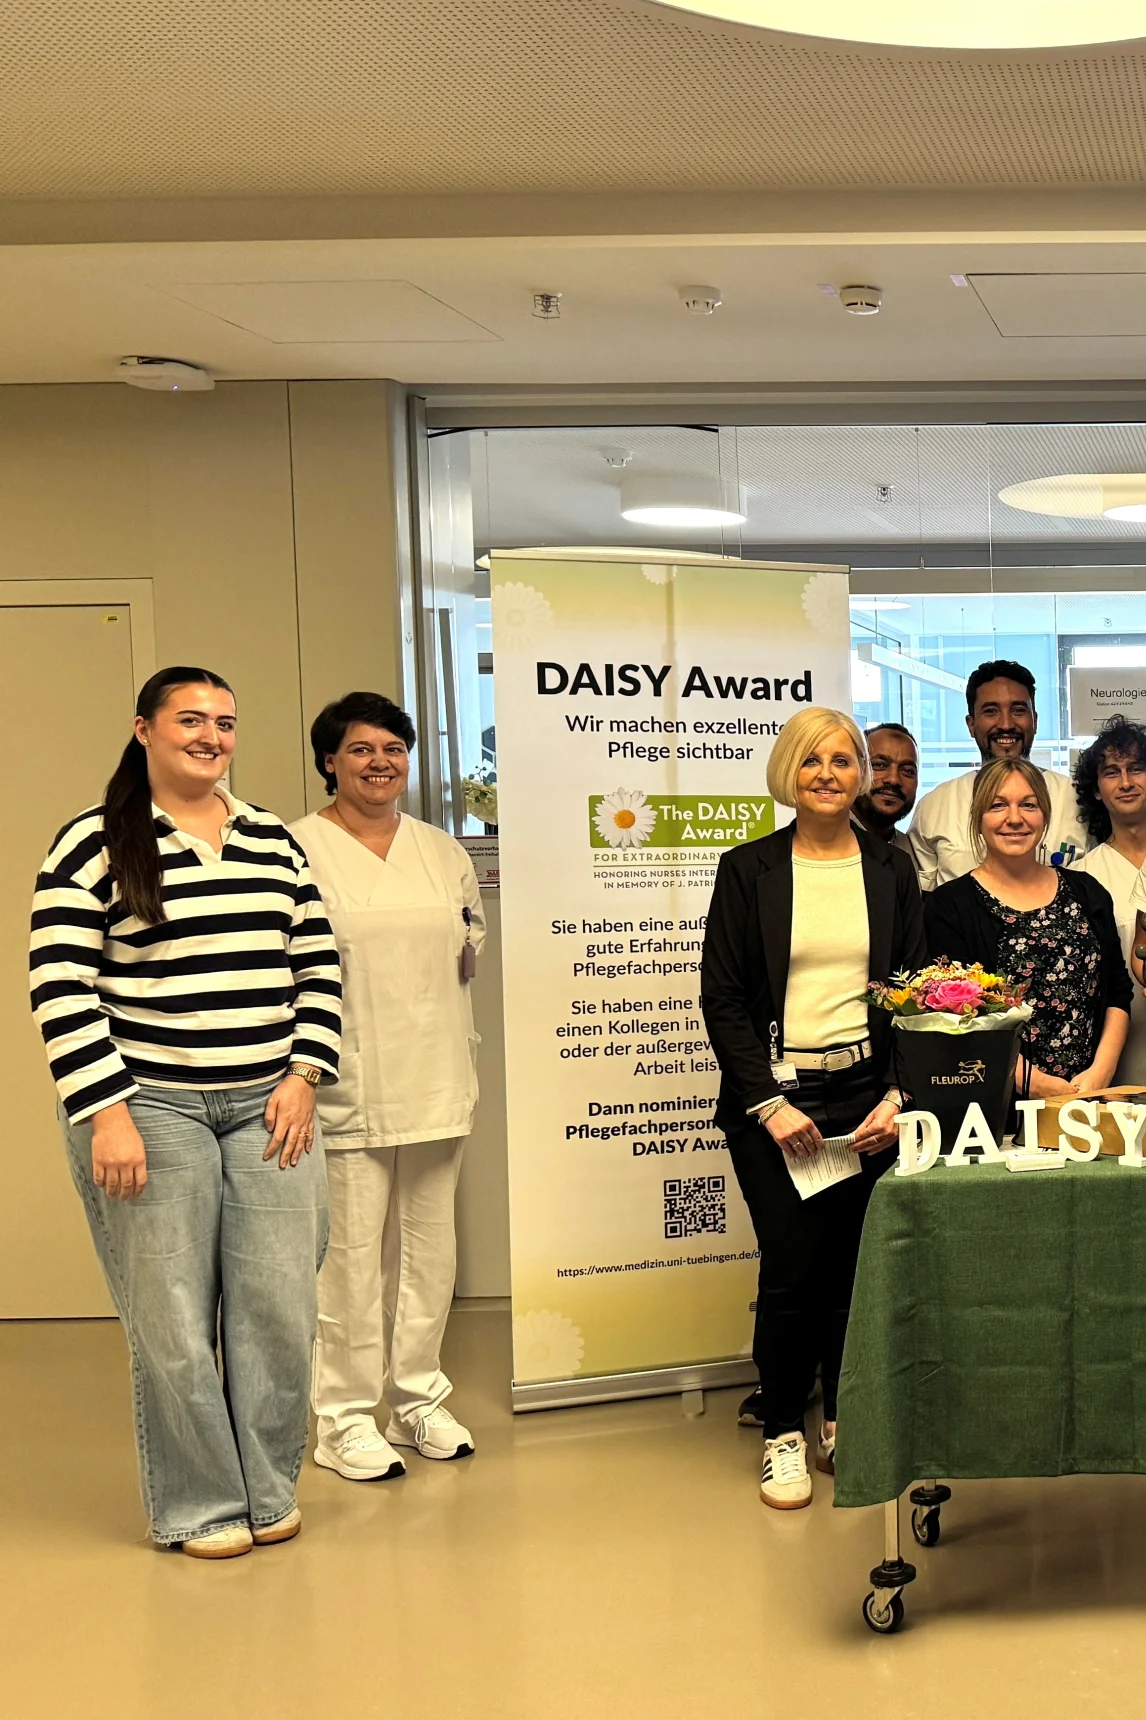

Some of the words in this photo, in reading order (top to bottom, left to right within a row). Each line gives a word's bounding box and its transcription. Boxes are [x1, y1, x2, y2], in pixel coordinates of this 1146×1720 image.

[537, 661, 671, 697] DAISY
[682, 666, 813, 702] Award
[1090, 688, 1146, 699] Neurologie
[565, 715, 603, 732] Wir
[609, 716, 687, 733] machen
[608, 741, 670, 761] Pflege
[676, 742, 754, 760] sichtbar
[659, 805, 694, 820] The
[698, 802, 766, 820] DAISY
[594, 853, 618, 862] FOR
[594, 870, 648, 878] HONORING
[617, 881, 659, 889] MEMORY
[551, 920, 577, 934] Sie
[582, 918, 634, 934] haben
[639, 917, 674, 932] eine
[586, 940, 624, 958] gute
[571, 1000, 597, 1015] Sie
[602, 998, 653, 1014] haben
[658, 996, 693, 1011] eine
[556, 1023, 603, 1038] einen
[608, 1018, 680, 1036] Kollegen
[685, 1017, 699, 1031] in
[560, 1043, 599, 1059] oder
[604, 1042, 631, 1057] der
[633, 1060, 686, 1076] Arbeit
[931, 1076, 975, 1085] FLEUROP
[588, 1102, 634, 1117] Dann
[639, 1095, 719, 1114] nominier
[632, 1138, 689, 1156] DAISY
